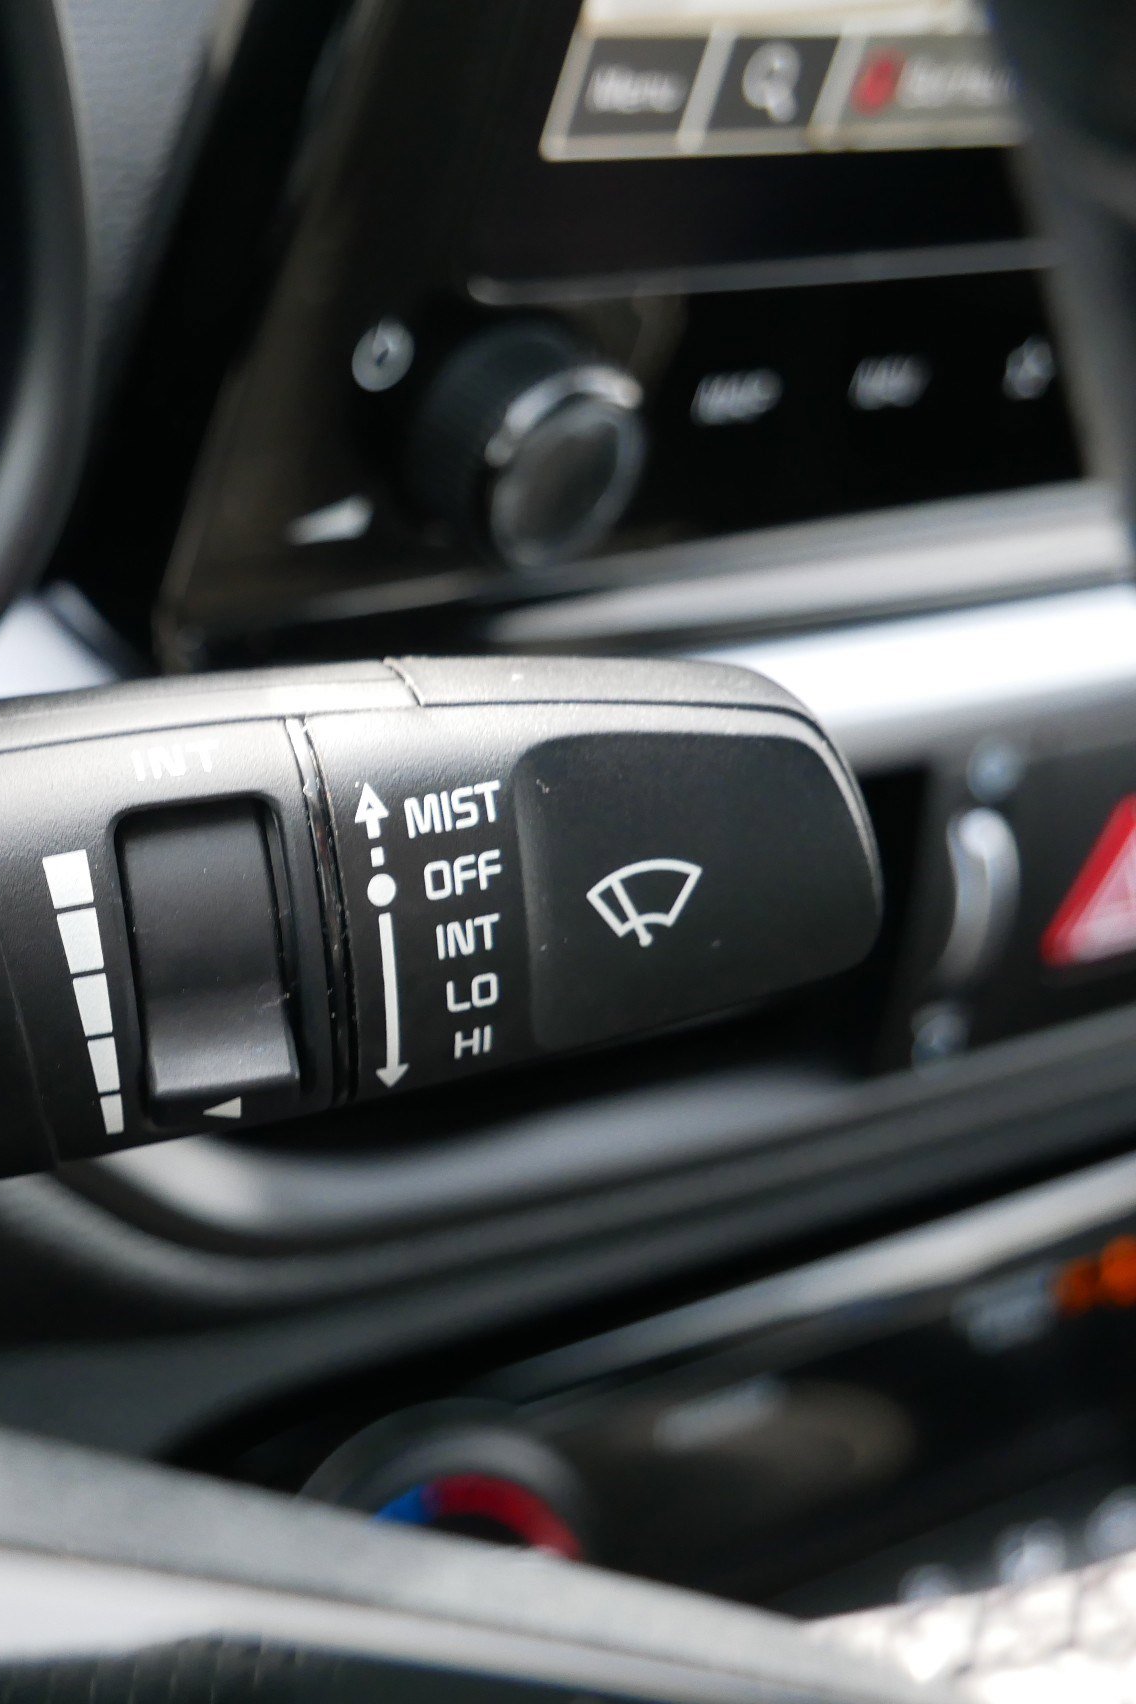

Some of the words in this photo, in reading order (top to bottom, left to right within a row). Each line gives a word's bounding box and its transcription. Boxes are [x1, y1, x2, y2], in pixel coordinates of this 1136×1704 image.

[130, 740, 220, 782] INT
[403, 780, 501, 839] MIST
[423, 849, 503, 901] OFF
[435, 912, 501, 961] INT
[446, 972, 499, 1013] LO
[454, 1024, 493, 1060] HI
